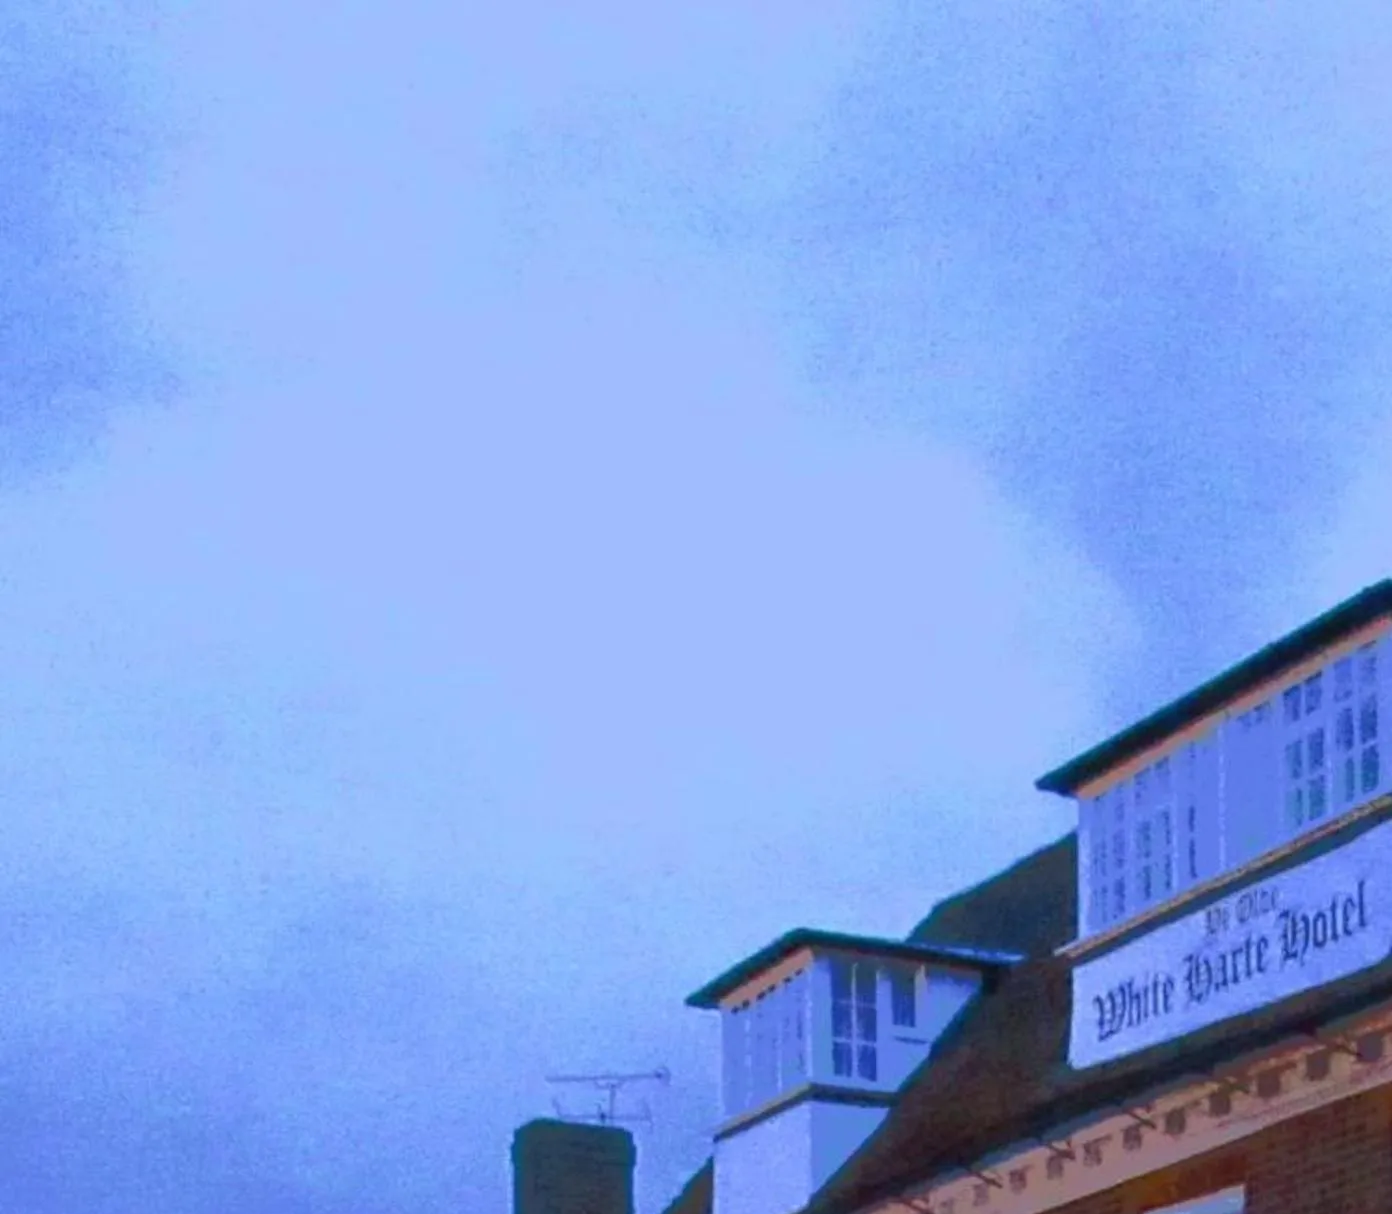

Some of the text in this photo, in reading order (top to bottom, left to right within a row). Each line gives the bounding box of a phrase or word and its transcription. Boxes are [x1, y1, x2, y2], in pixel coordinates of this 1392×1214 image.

[1093, 879, 1367, 1042] White Harte Hotel
